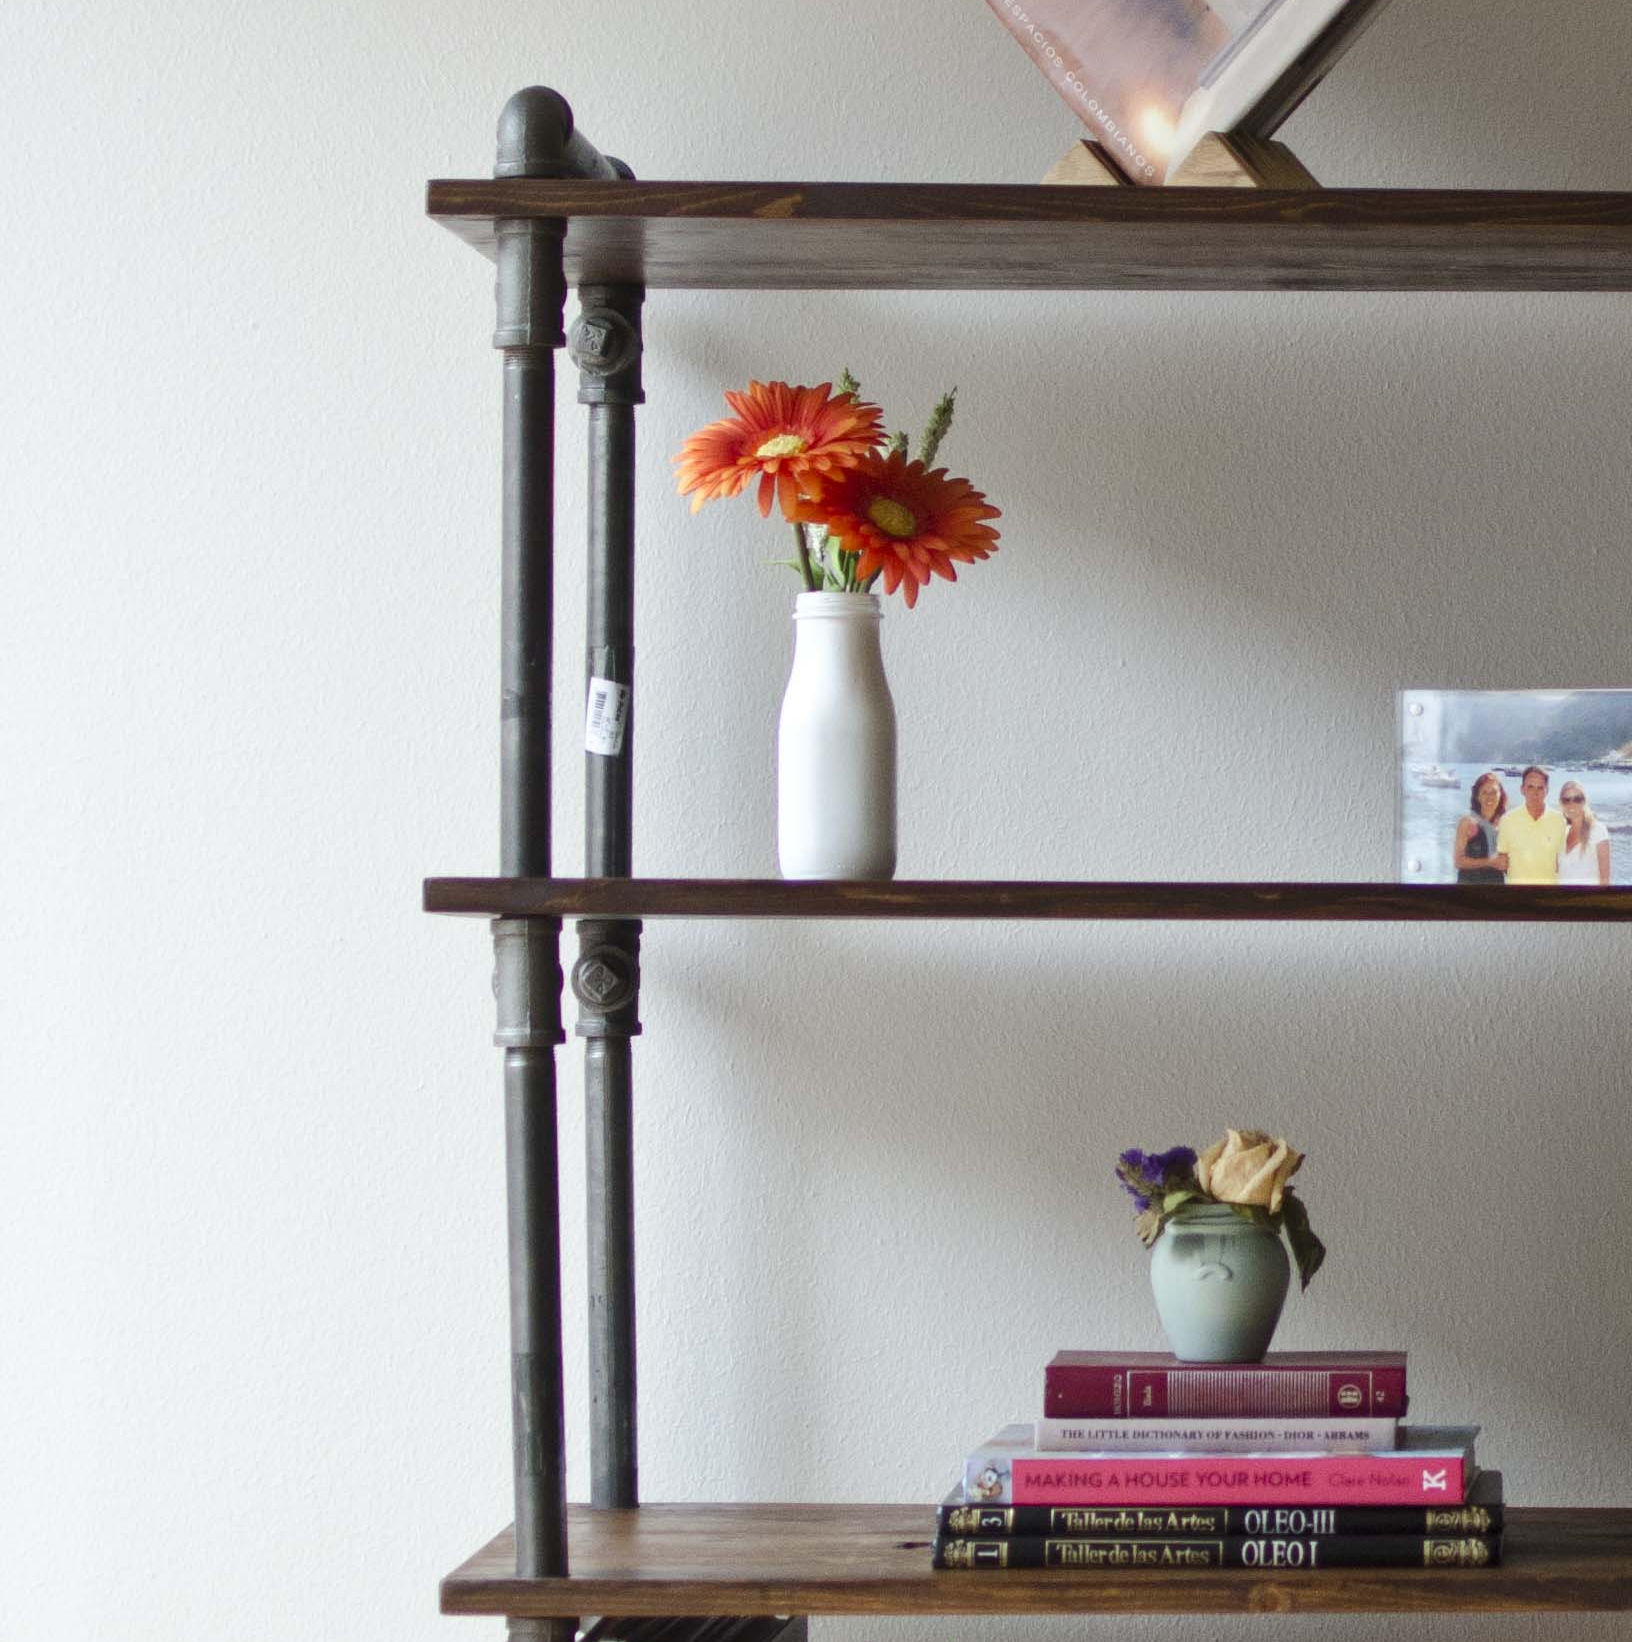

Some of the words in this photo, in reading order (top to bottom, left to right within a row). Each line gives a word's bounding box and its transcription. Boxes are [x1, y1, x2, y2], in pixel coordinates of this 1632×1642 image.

[1064, 70, 1155, 177] COLOMBIANOS
[1061, 1429, 1084, 1439] THE
[1088, 1429, 1129, 1439] LITTLE
[1132, 1429, 1203, 1440] DICTIONARY
[1206, 1430, 1221, 1440] OF
[1224, 1430, 1275, 1440] FASHION
[1284, 1430, 1314, 1440] DIOR
[1025, 1471, 1101, 1488] MAKING
[1108, 1471, 1120, 1488] A
[1124, 1471, 1190, 1488] HOUSE
[1195, 1470, 1248, 1487] YOUR
[1254, 1470, 1313, 1487] HOME
[1422, 1469, 1447, 1491] K
[981, 1517, 1002, 1527] 3
[1061, 1511, 1109, 1531] Taller
[1114, 1511, 1129, 1530] de
[1138, 1511, 1162, 1531] las
[1167, 1511, 1215, 1532] Artes
[1244, 1510, 1336, 1534] OLEO-III
[1056, 1544, 1107, 1564] Taller
[1109, 1544, 1125, 1564] de
[1132, 1544, 1157, 1564] las
[1160, 1544, 1209, 1565] Artes
[1241, 1540, 1304, 1566] OLEO
[1310, 1541, 1318, 1566] I
